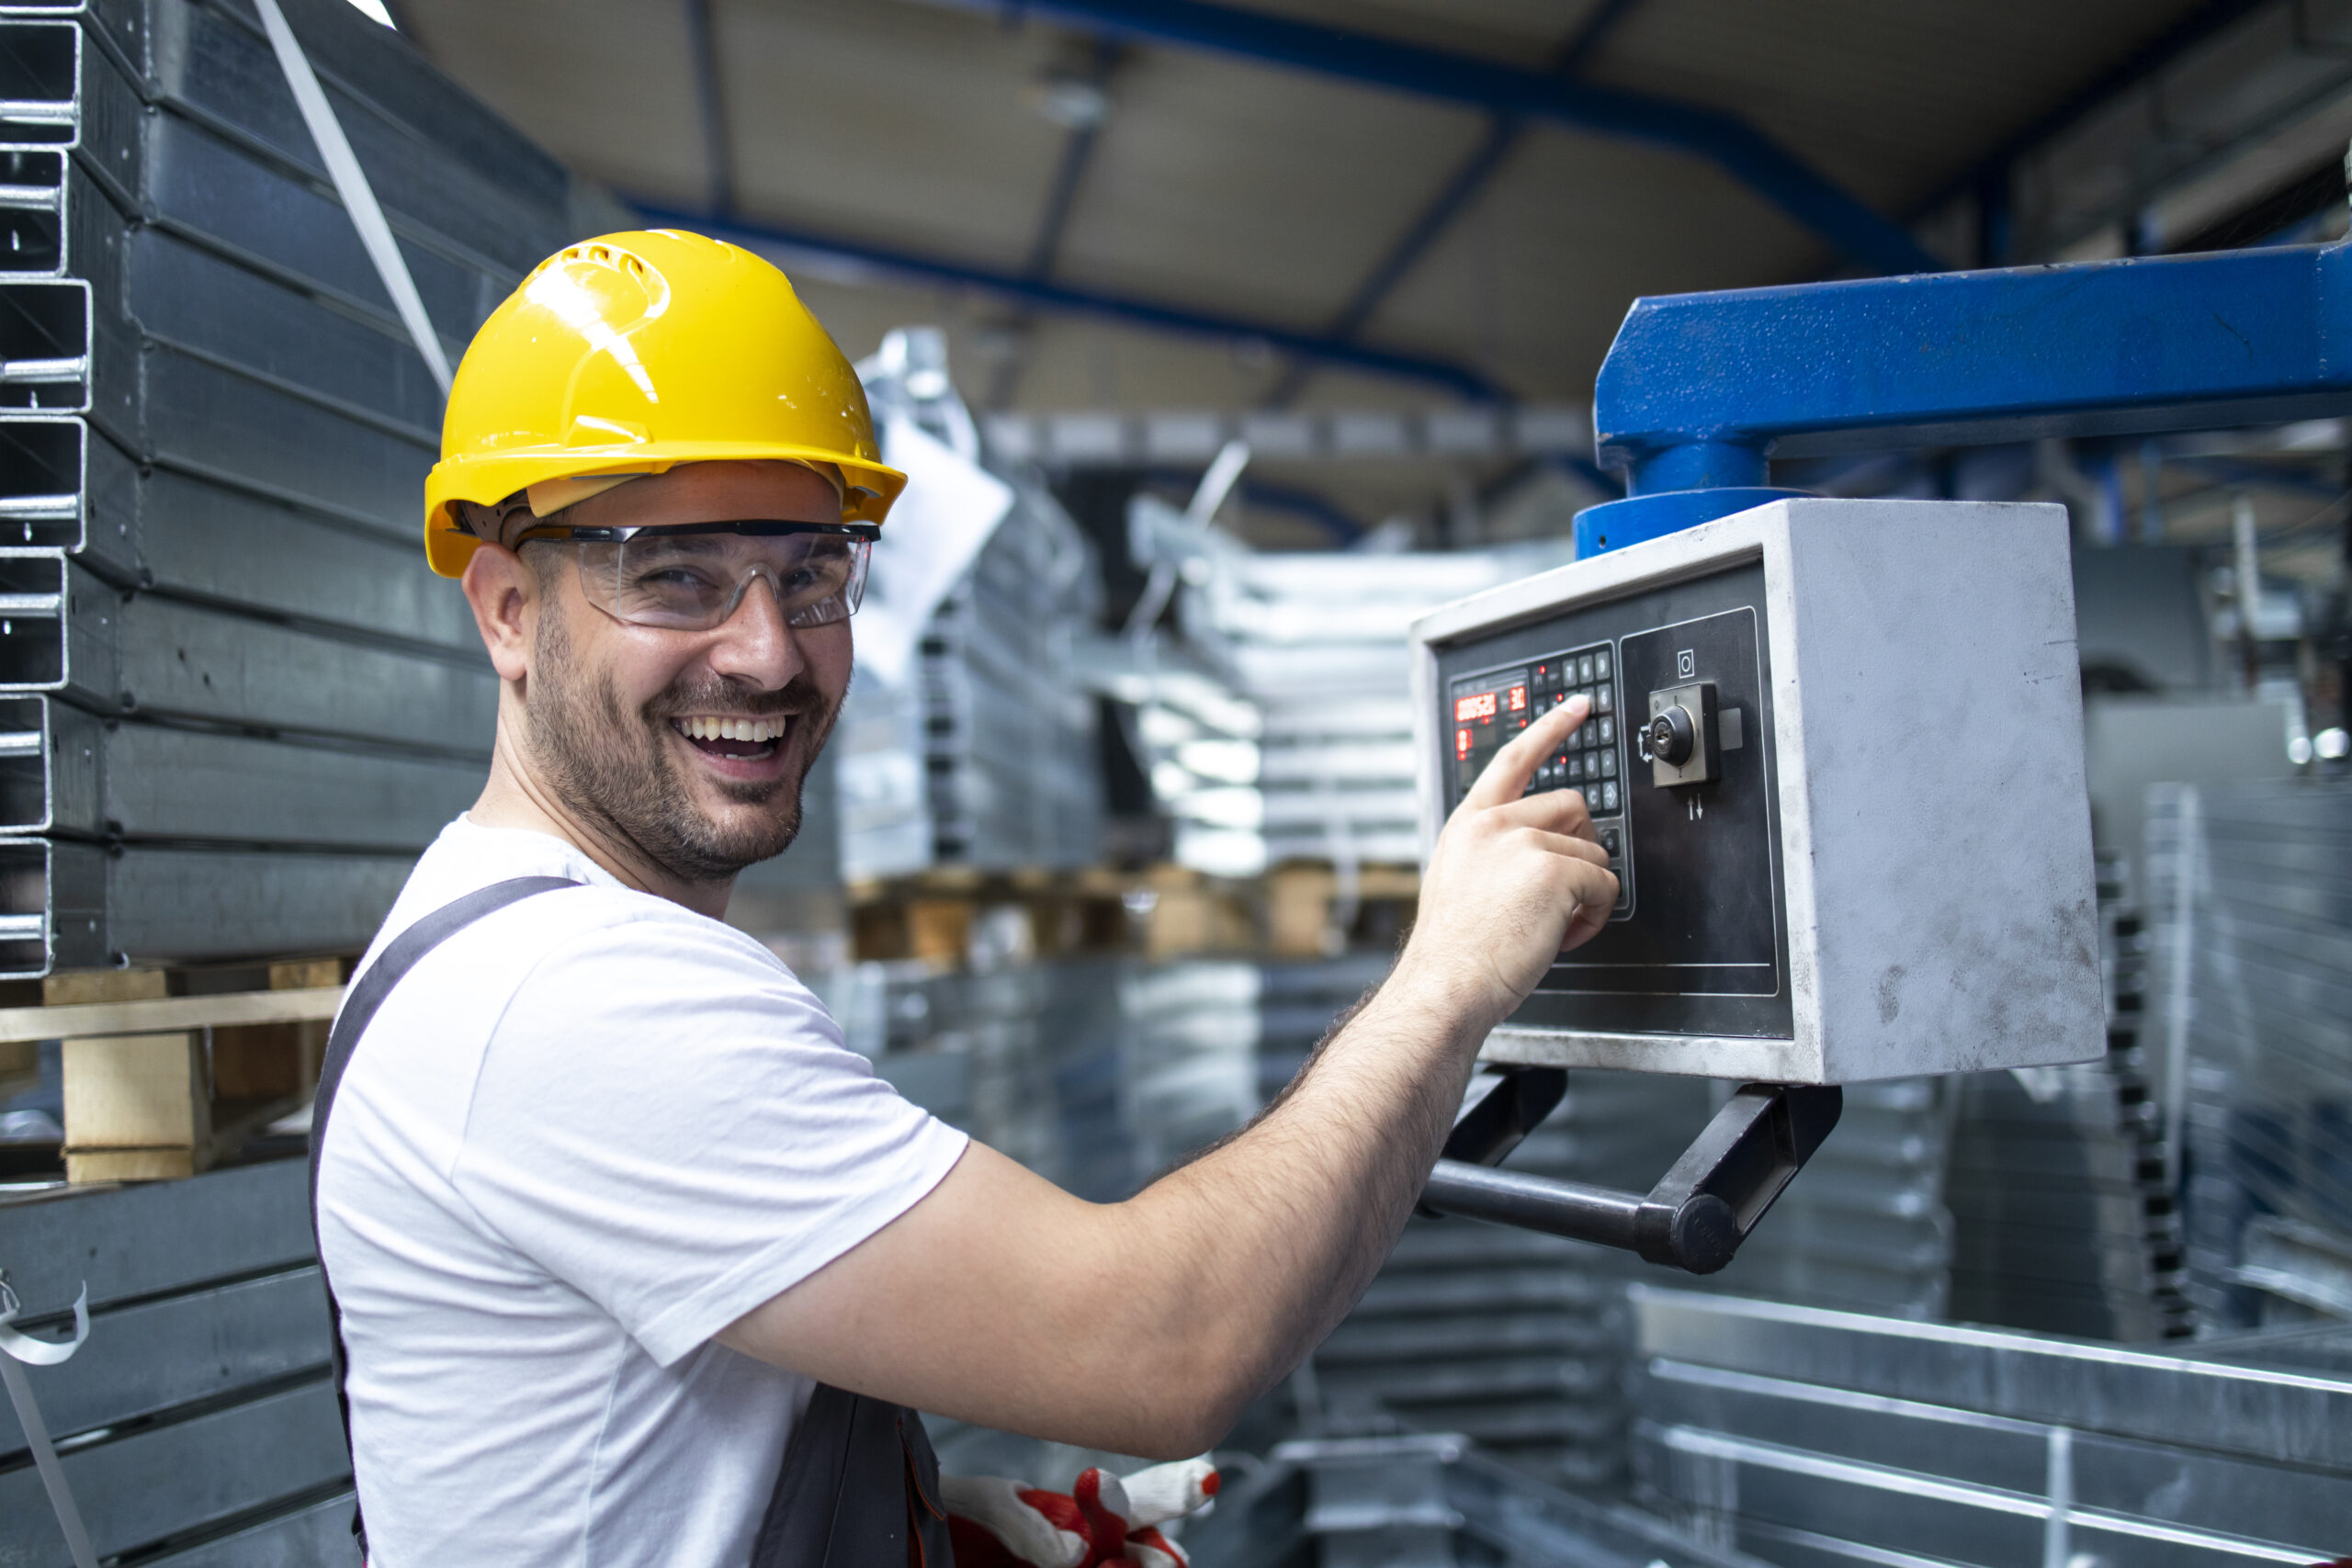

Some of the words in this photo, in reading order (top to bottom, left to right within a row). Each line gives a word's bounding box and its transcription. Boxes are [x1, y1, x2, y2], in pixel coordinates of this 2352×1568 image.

[1566, 665, 1573, 681] 7
[1599, 659, 1606, 673] 9
[1600, 691, 1608, 705] 6
[1587, 727, 1593, 740] 2
[1602, 723, 1610, 738] 3
[1589, 790, 1597, 805] C
